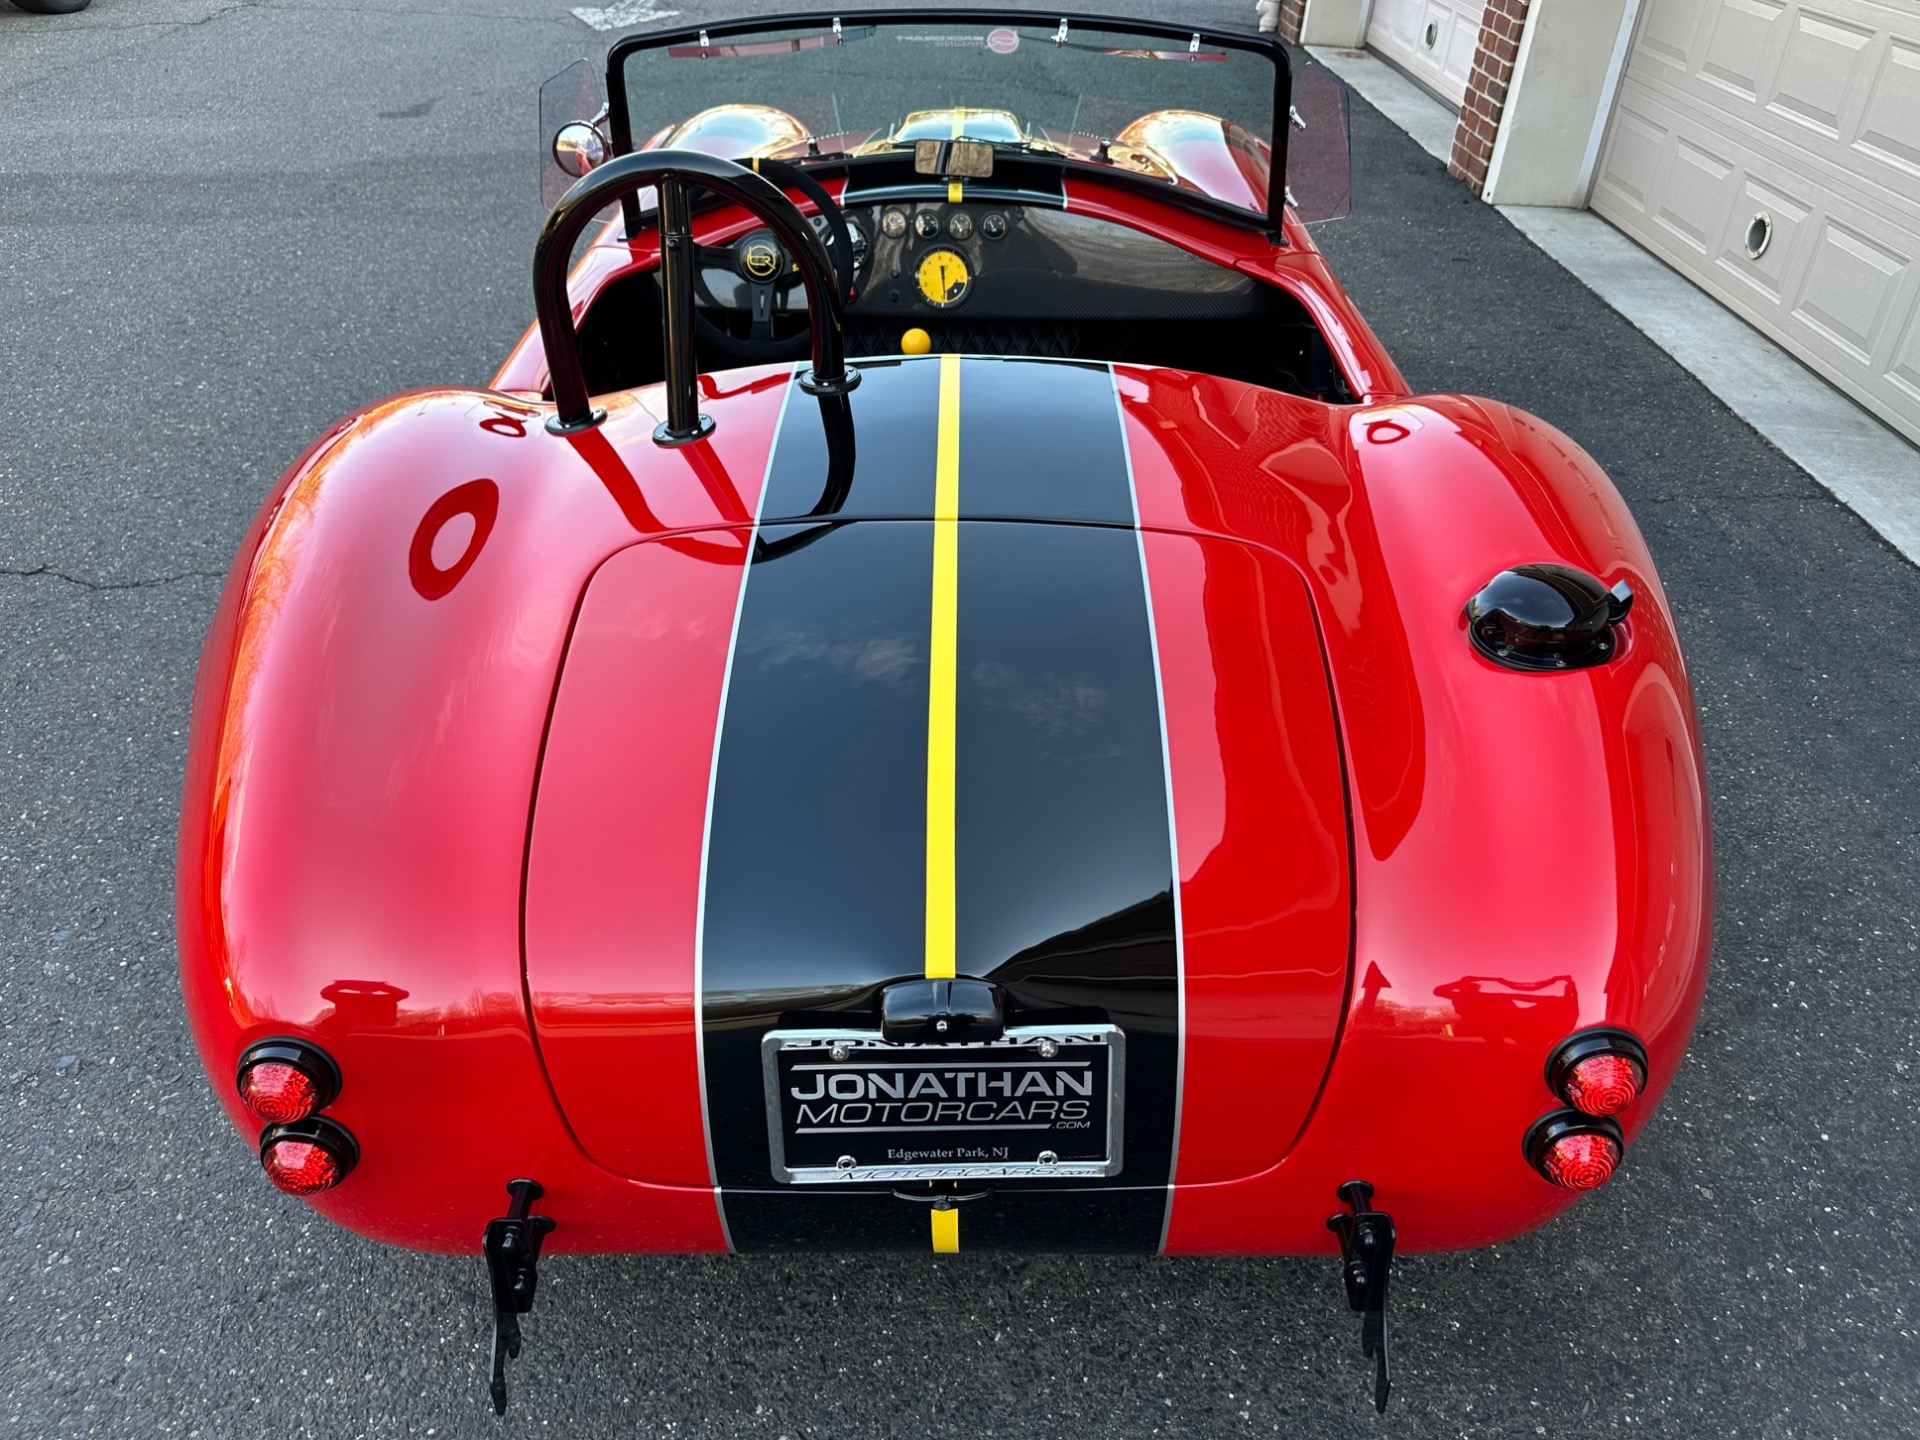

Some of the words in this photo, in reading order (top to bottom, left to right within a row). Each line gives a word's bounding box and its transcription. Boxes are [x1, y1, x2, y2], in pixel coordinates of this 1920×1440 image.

[790, 1070, 1093, 1101] JONATHAN
[796, 1100, 1090, 1125] MOTORCARS
[887, 1147, 954, 1160] Edgewater
[957, 1147, 989, 1159] Park,
[992, 1147, 1009, 1158] NJ
